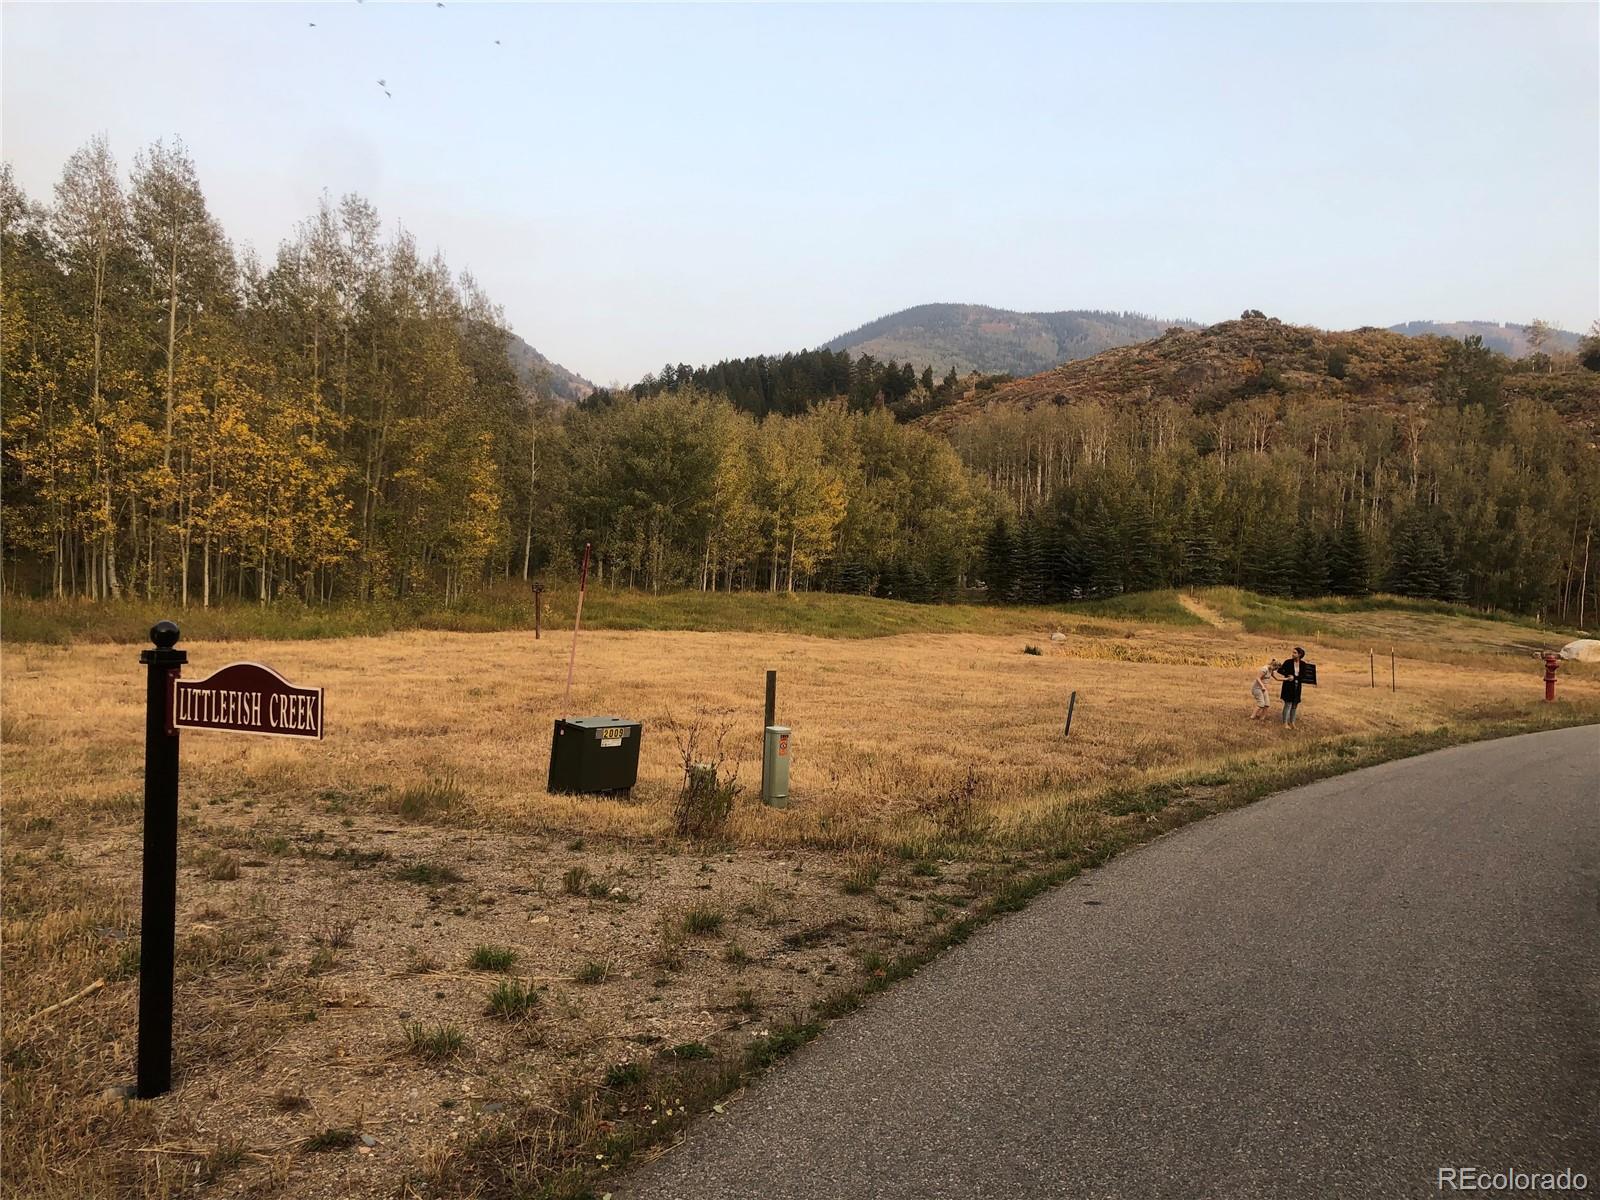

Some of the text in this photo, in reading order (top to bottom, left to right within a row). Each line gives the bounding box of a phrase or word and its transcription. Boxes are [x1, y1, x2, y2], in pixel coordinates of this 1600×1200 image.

[179, 688, 317, 731] LITTLEFISH CREEK
[603, 728, 624, 738] 2009
